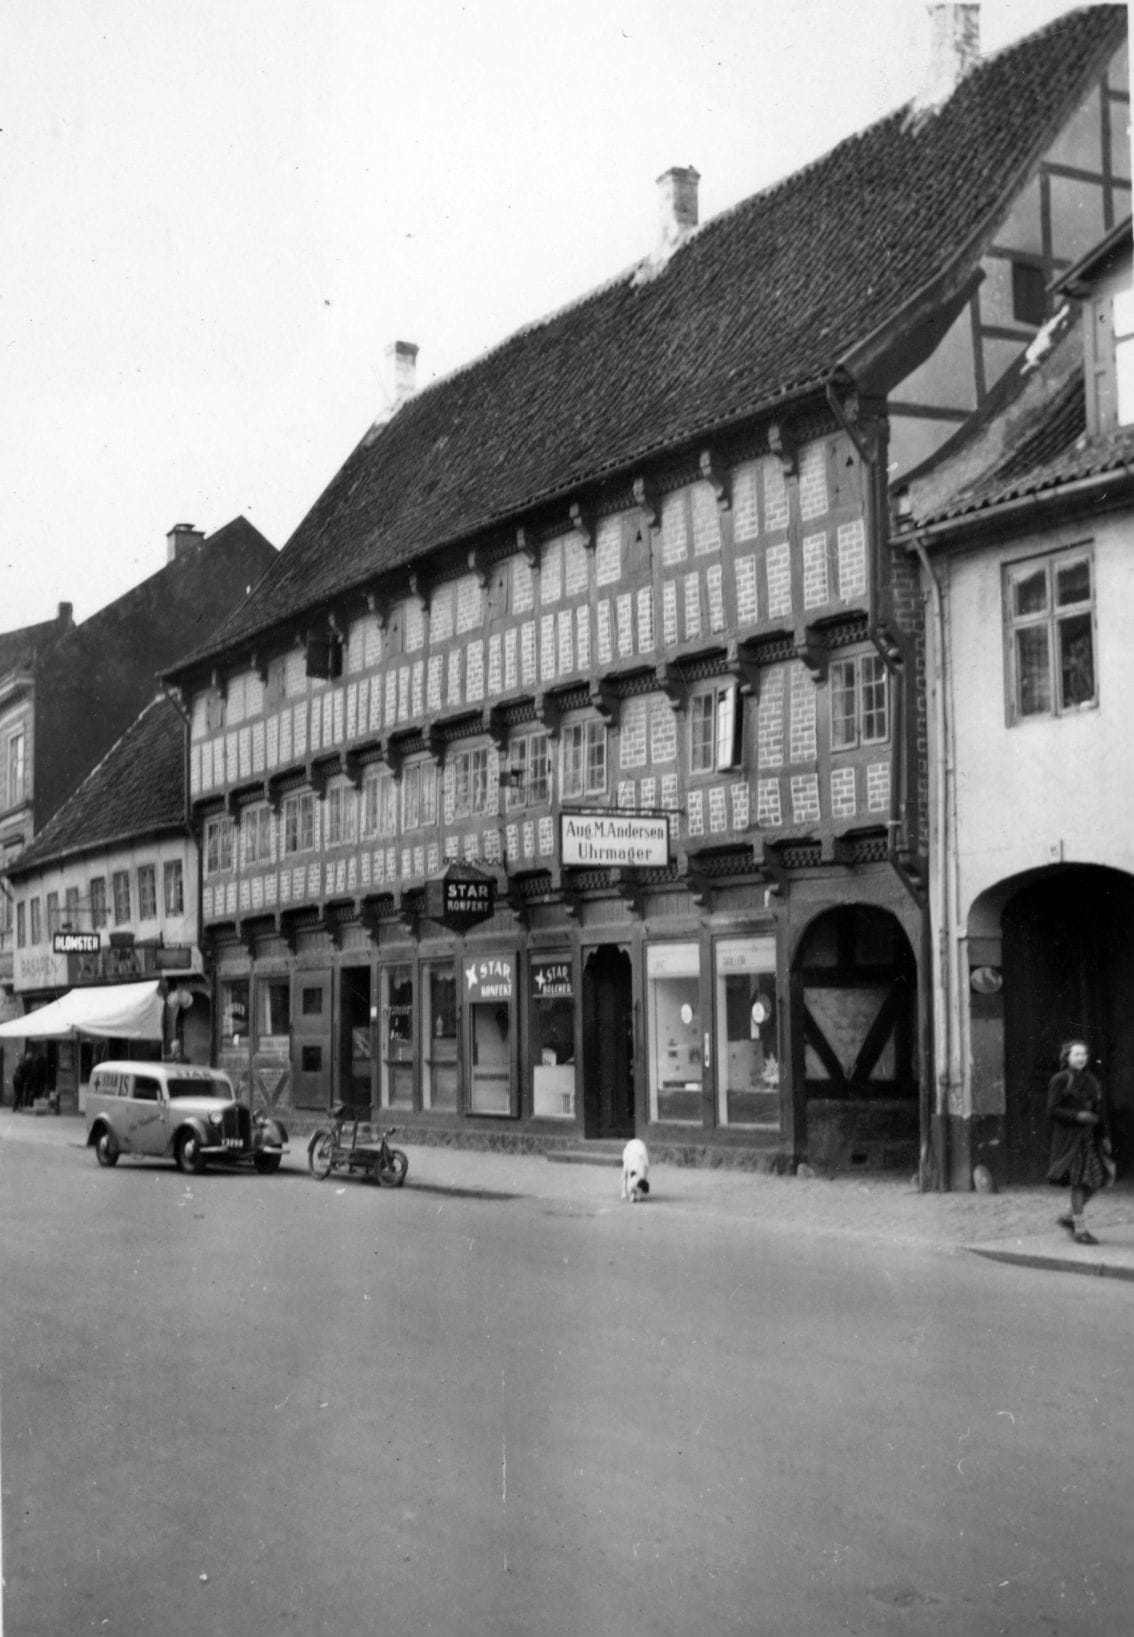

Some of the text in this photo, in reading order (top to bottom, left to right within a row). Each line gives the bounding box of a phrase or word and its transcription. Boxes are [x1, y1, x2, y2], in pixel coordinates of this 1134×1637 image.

[578, 842, 652, 865] Uhrmager
[448, 884, 488, 898] STAR
[447, 899, 489, 912] KONFEKT
[480, 960, 511, 983] STAR
[546, 965, 569, 983] STAR
